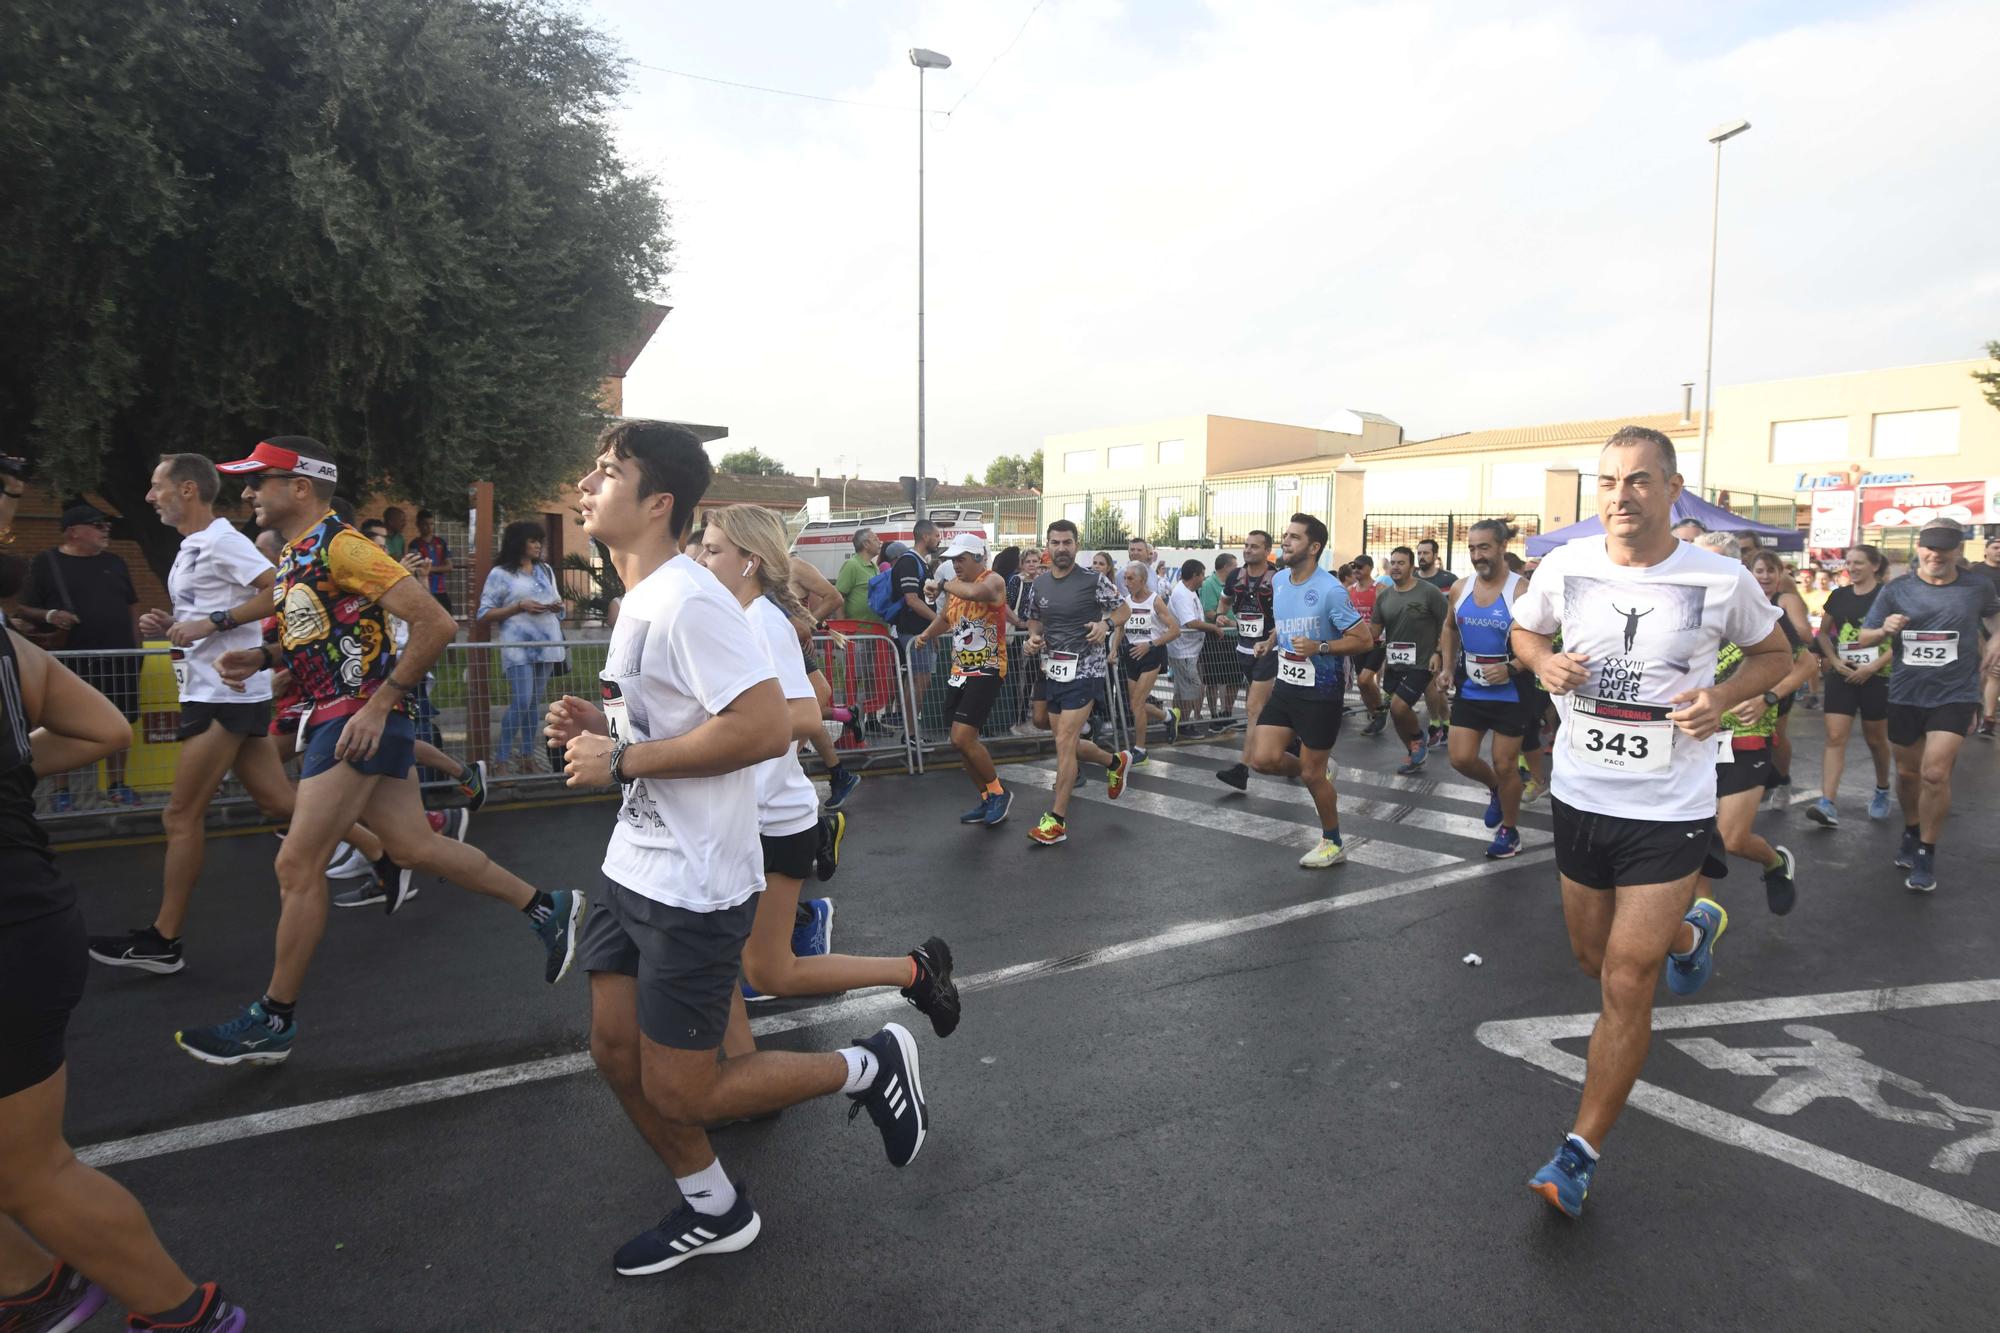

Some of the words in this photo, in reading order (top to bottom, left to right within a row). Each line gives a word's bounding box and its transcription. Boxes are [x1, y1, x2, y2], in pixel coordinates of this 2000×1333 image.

[1129, 617, 1146, 625] 510
[1275, 616, 1321, 634] PLEMENTE
[1464, 617, 1508, 630] TAKASAGO
[1240, 624, 1258, 633] 376
[1391, 652, 1410, 661] 642
[1847, 654, 1871, 664] 523
[1911, 646, 1947, 659] 452
[1050, 664, 1068, 676] 451
[1604, 656, 1645, 671] XXVIII
[1283, 664, 1306, 680] 542
[1601, 667, 1642, 682] NON
[1598, 678, 1641, 694] DUER
[1574, 695, 1596, 715] XXVIII
[1585, 729, 1649, 759] 343
[1604, 758, 1625, 767] PACO
